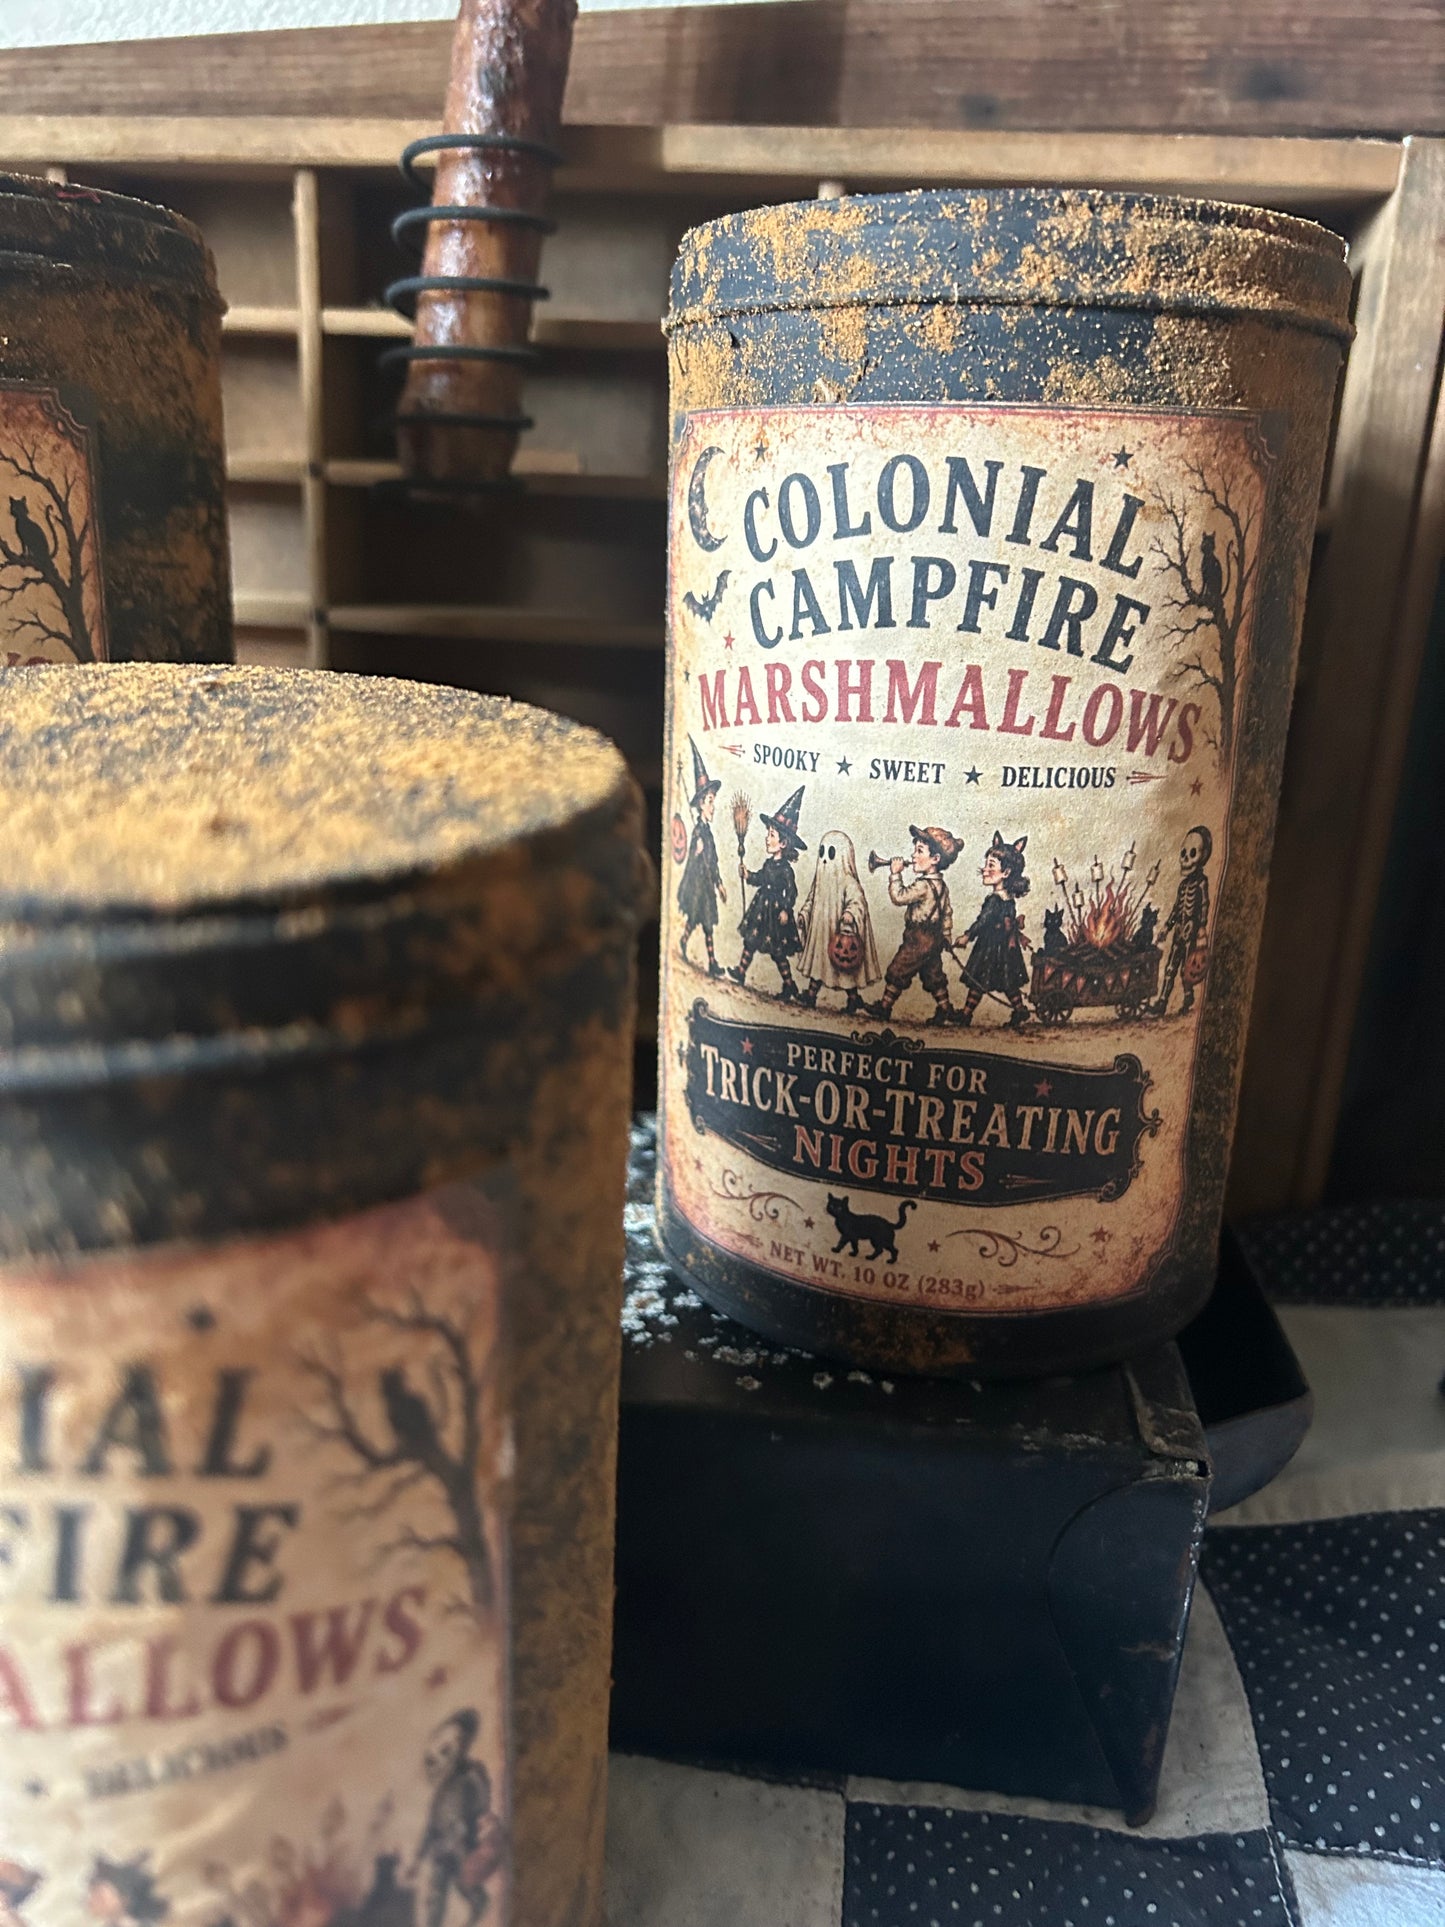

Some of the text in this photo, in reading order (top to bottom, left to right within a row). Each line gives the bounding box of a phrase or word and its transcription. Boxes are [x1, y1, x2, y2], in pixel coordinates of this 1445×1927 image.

[743, 453, 1146, 579] COLONIAL
[750, 556, 1151, 675] CAMPFIRE
[699, 659, 1202, 764] MARSHMALLOWS
[753, 743, 1117, 789] SPOOKY SWEET DELICIOUS
[700, 1042, 1122, 1156] TRICK-OR-TREATING
[786, 1042, 988, 1095] PERFECT FOR
[792, 1124, 986, 1191] NIGHTS
[769, 1239, 986, 1300] NET WT. 10 OZ (283g)
